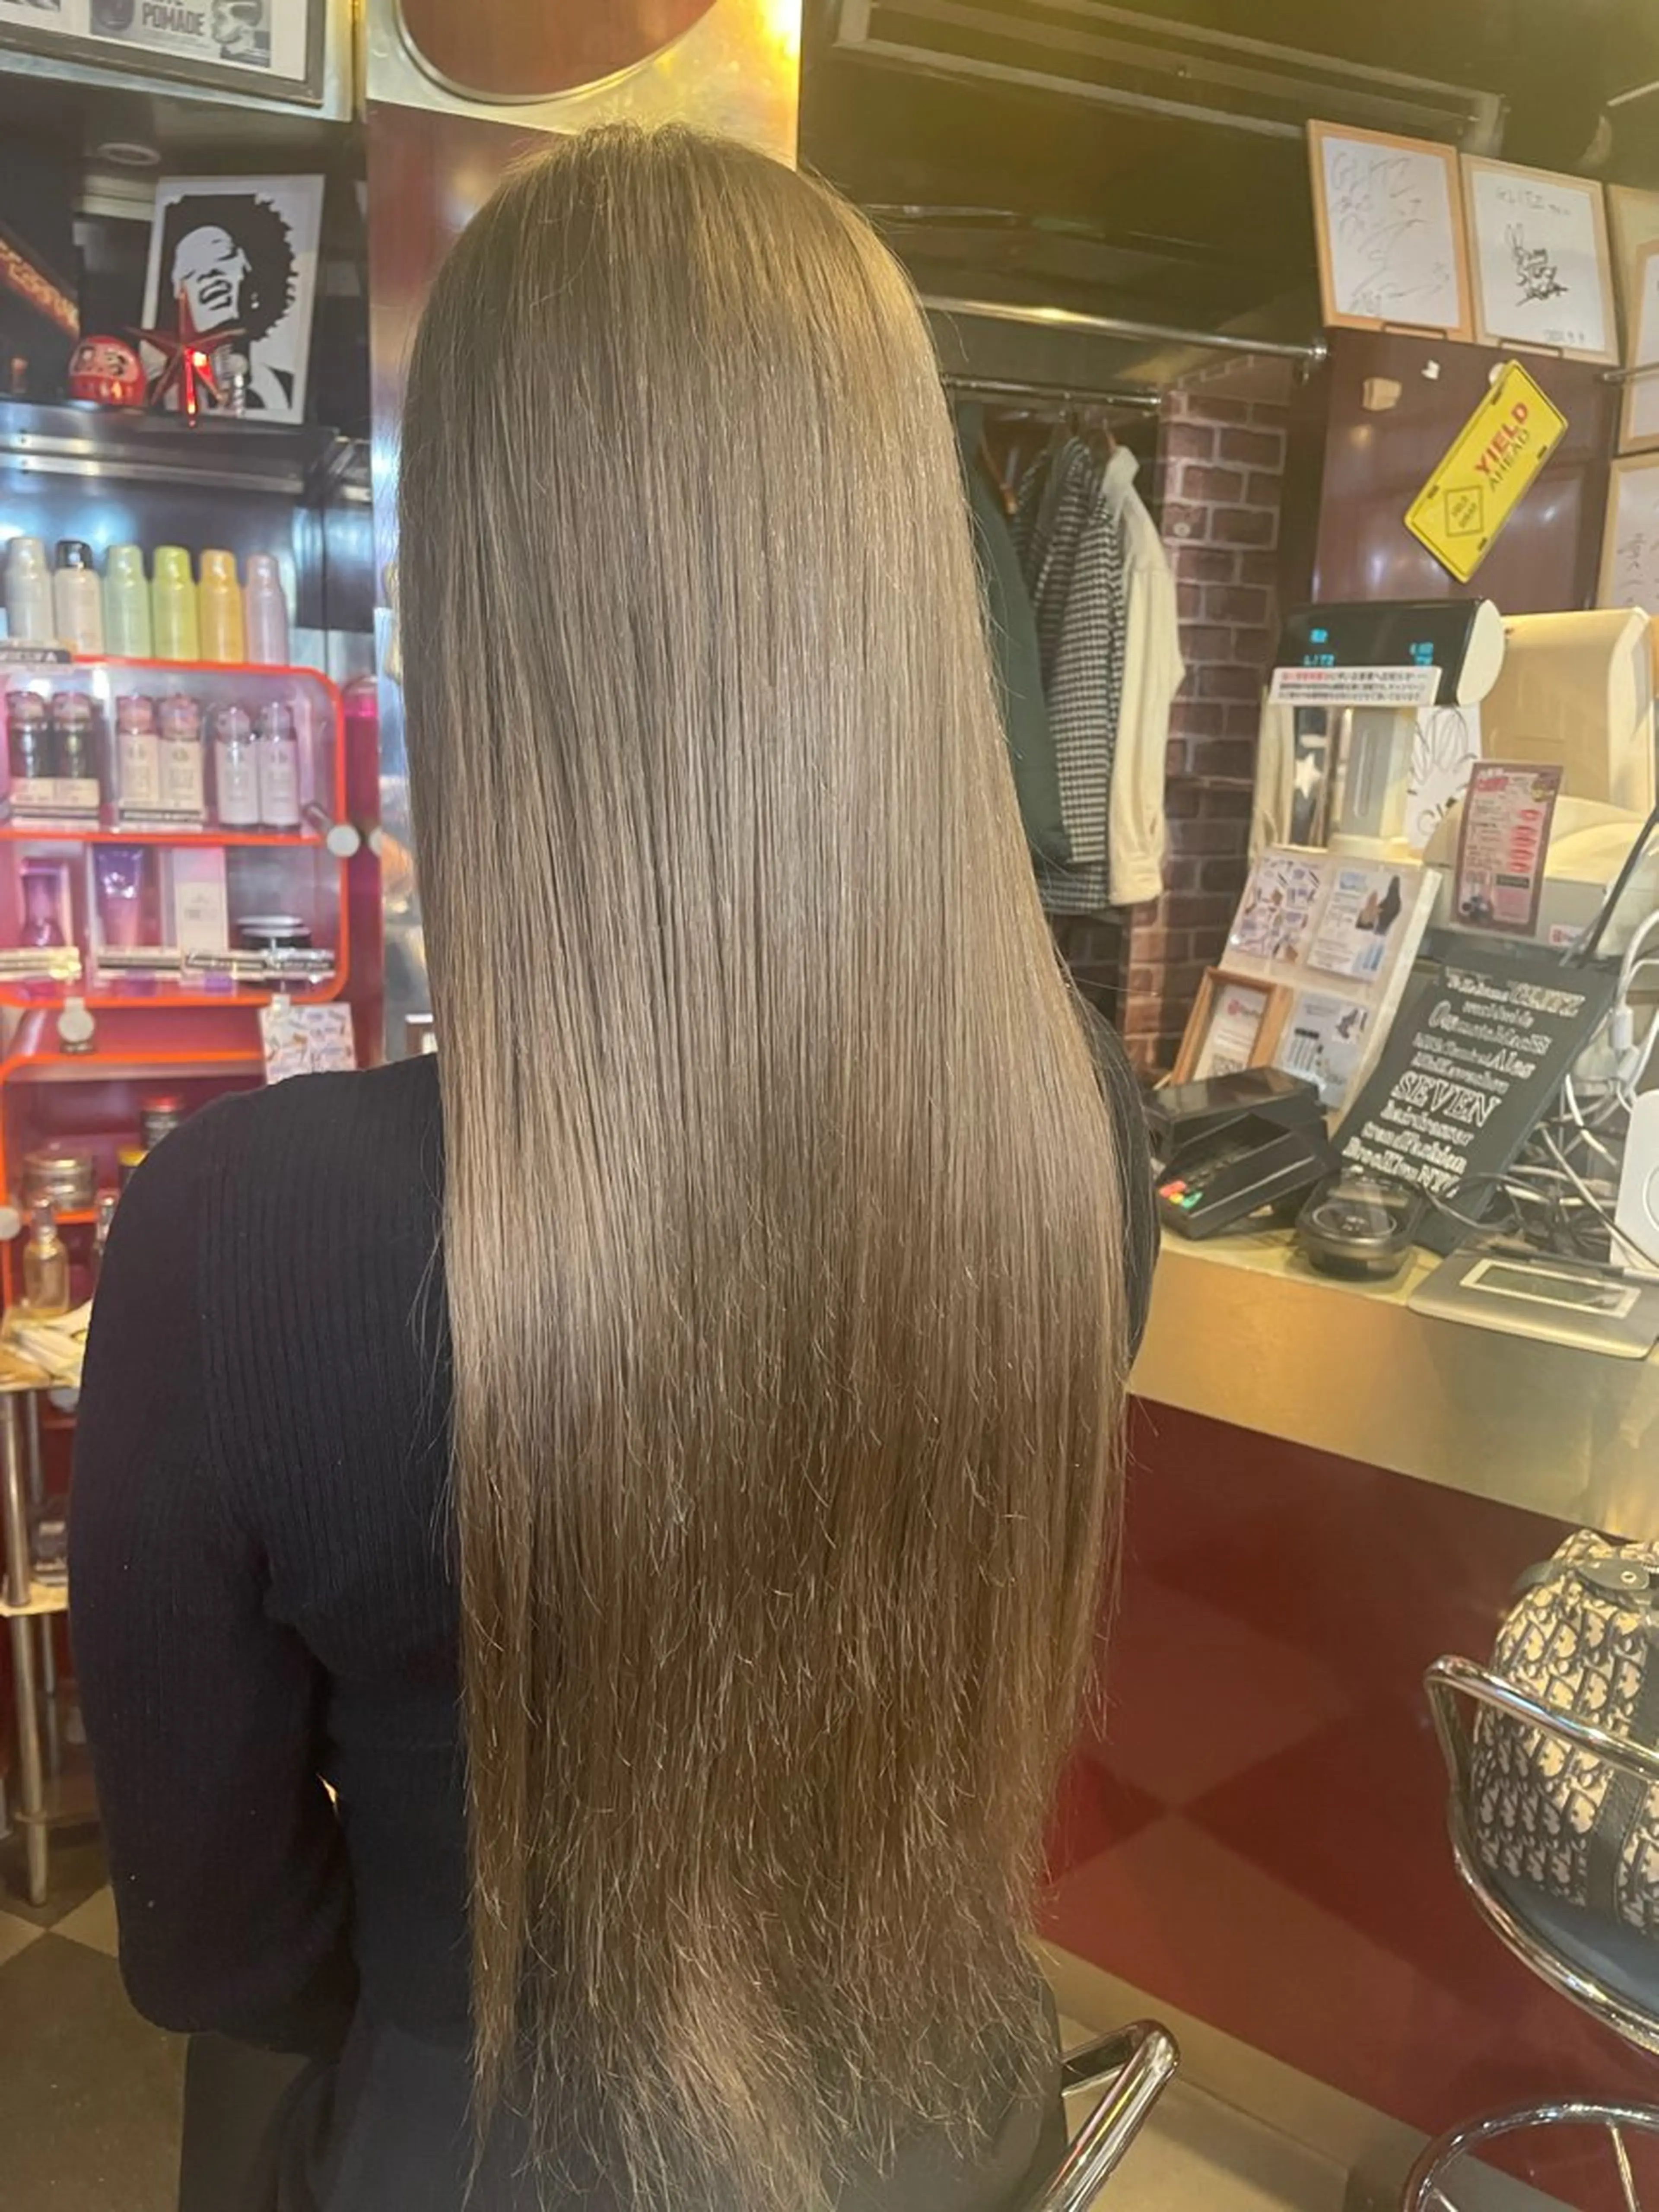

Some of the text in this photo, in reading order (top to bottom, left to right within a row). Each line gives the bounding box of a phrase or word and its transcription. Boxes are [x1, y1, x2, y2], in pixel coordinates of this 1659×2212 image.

[142, 1, 205, 36] POMADE
[1475, 402, 1529, 475] YIELD
[1489, 426, 1530, 493] AHEAD
[1390, 1071, 1502, 1128] SEVEN
